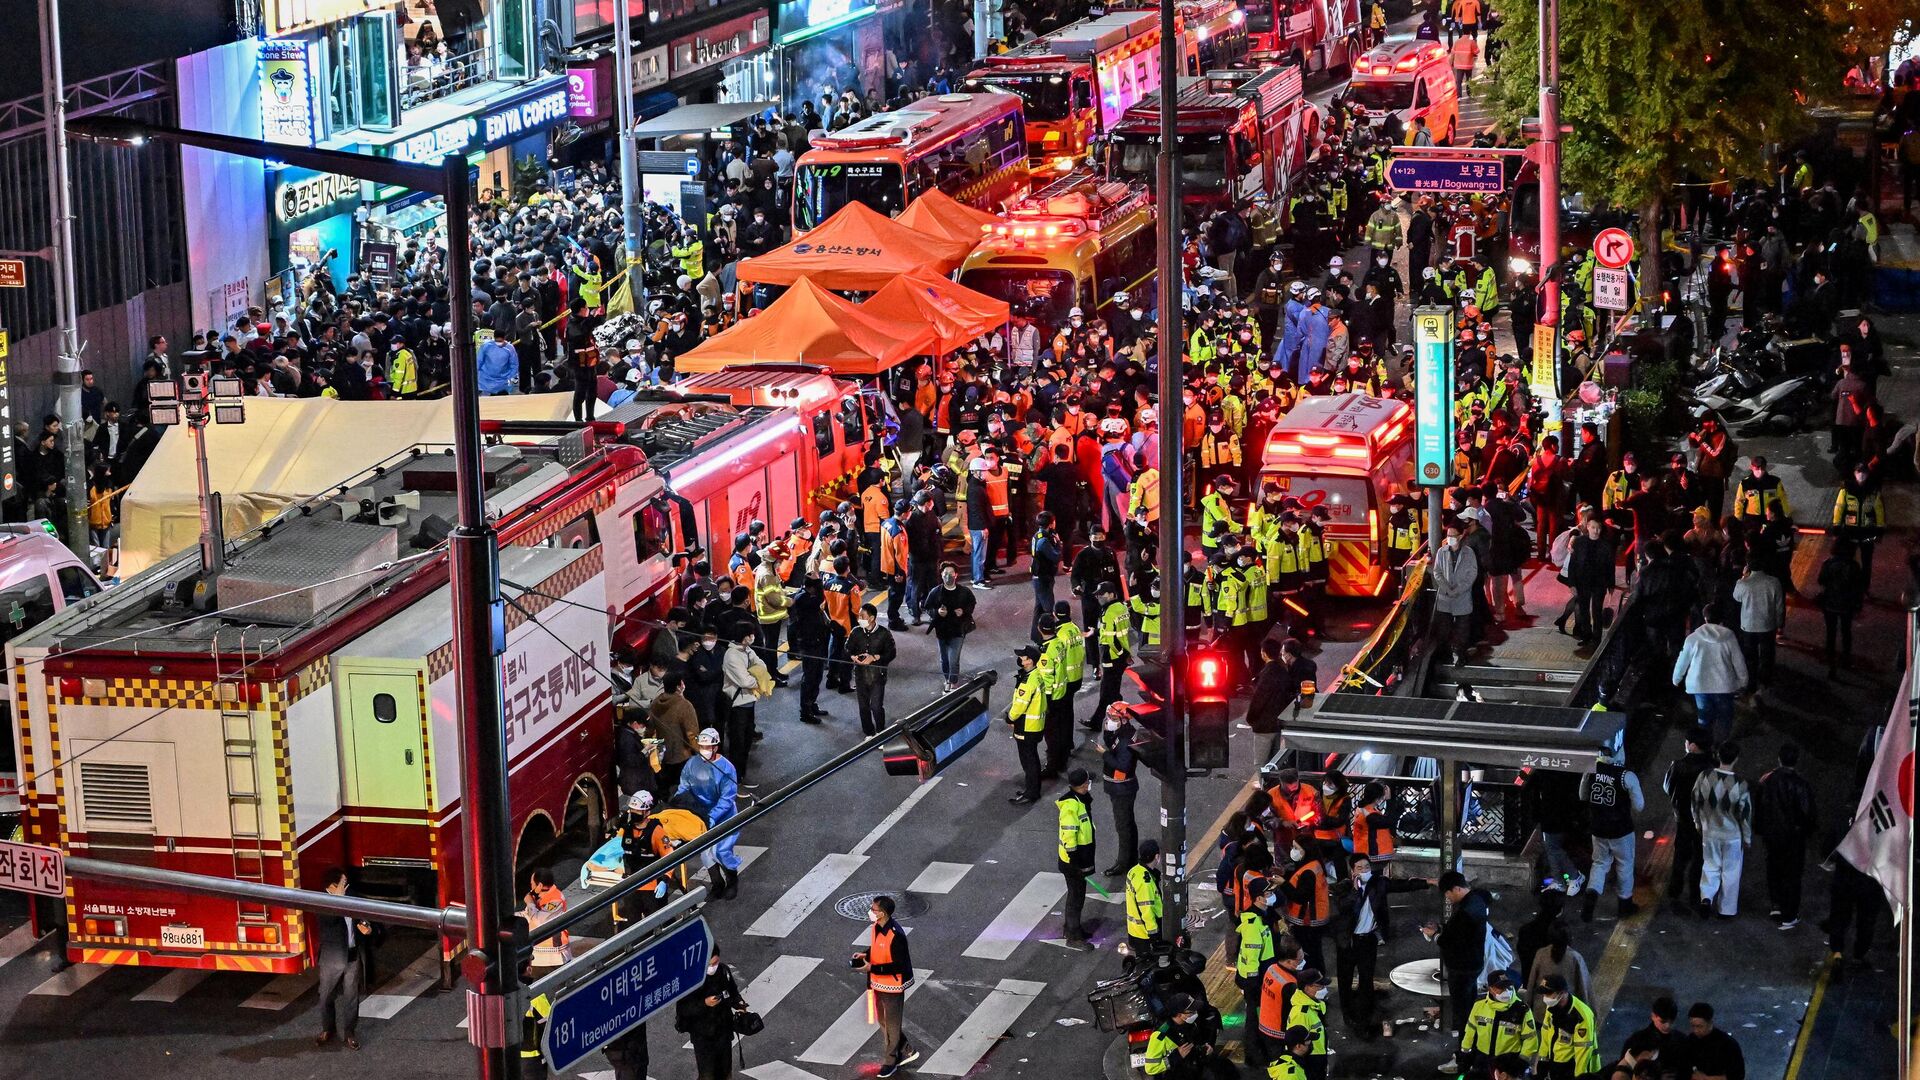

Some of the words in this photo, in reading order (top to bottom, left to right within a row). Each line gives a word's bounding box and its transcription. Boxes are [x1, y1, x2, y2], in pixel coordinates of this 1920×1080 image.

[486, 109, 522, 142] EDIYA
[522, 91, 567, 128] COFFEE
[814, 165, 842, 177] 119
[1459, 165, 1498, 178] 보광로
[815, 244, 882, 256] 용산소방서
[1425, 466, 1439, 475] 630
[1540, 756, 1571, 768] 용산구
[1595, 773, 1615, 786] PAYNE
[1590, 782, 1617, 807] 23
[0, 842, 60, 891] 좌회전
[83, 904, 124, 914] 서울특별시
[127, 907, 177, 917] 소방재난본부
[682, 940, 703, 971] 177
[601, 955, 658, 1006] 이태원로
[554, 1017, 576, 1049] 181
[581, 1006, 637, 1049] Itaewon-ro
